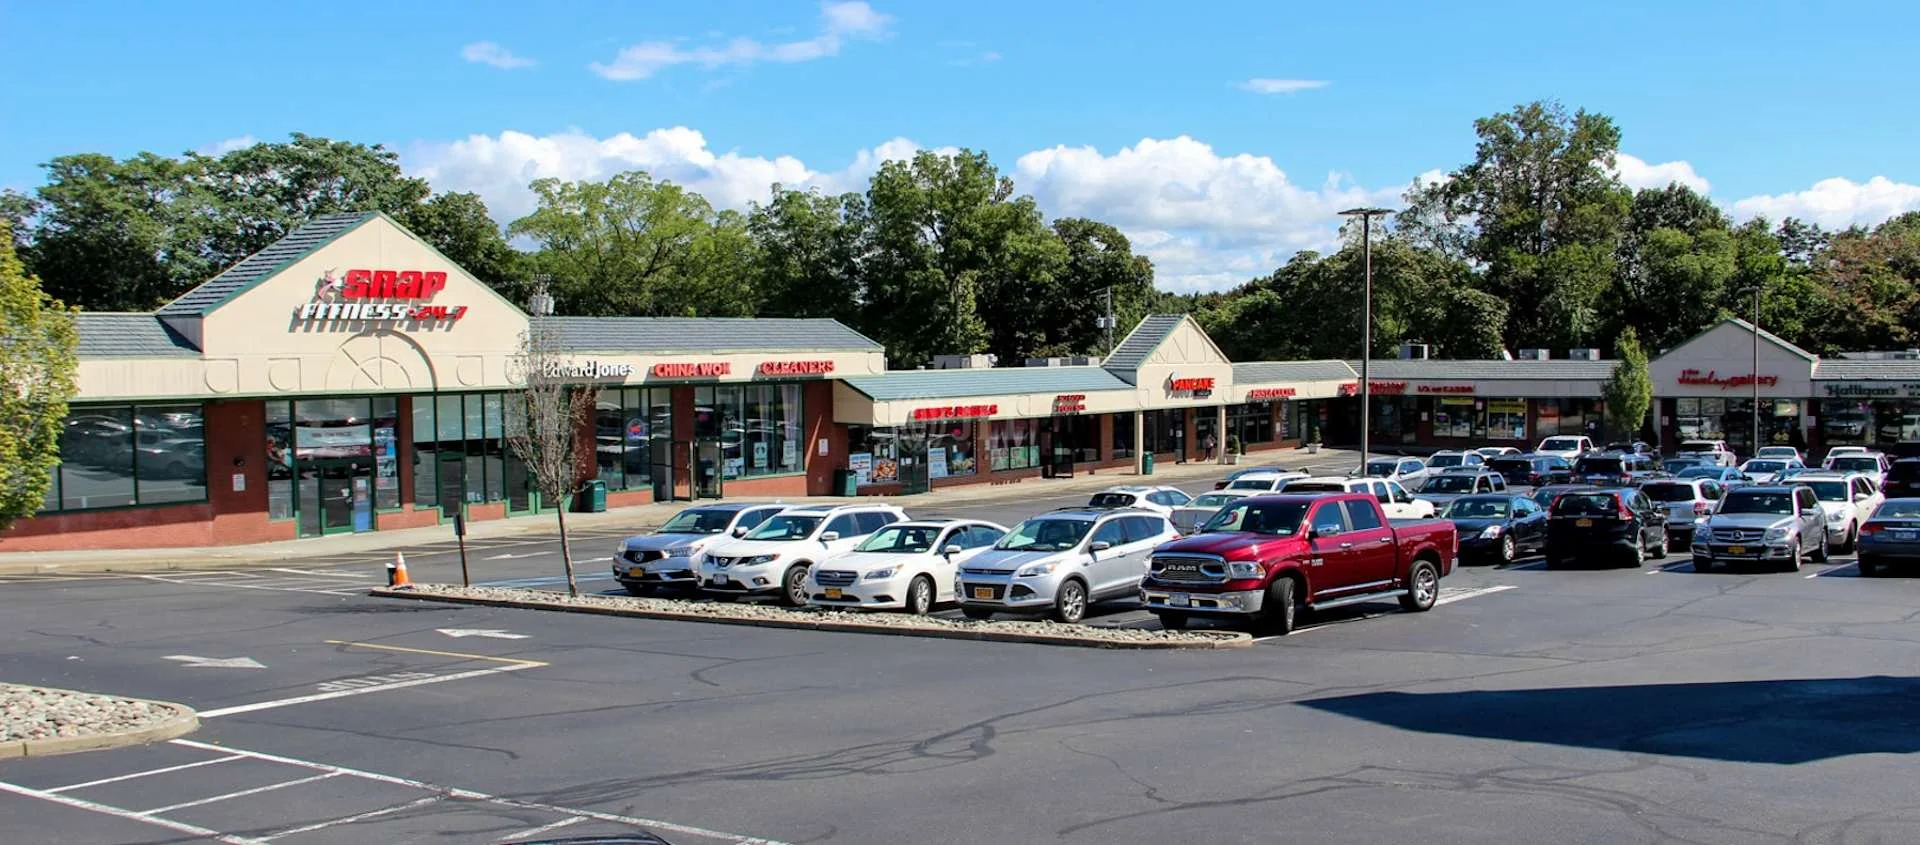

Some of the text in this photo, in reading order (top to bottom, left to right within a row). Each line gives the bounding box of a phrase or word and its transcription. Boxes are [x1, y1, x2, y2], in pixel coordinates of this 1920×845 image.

[300, 303, 408, 320] FITNESS
[543, 360, 636, 379] Edward Jones
[655, 363, 731, 377] CHINA WOK
[760, 360, 835, 374] CLEANERS
